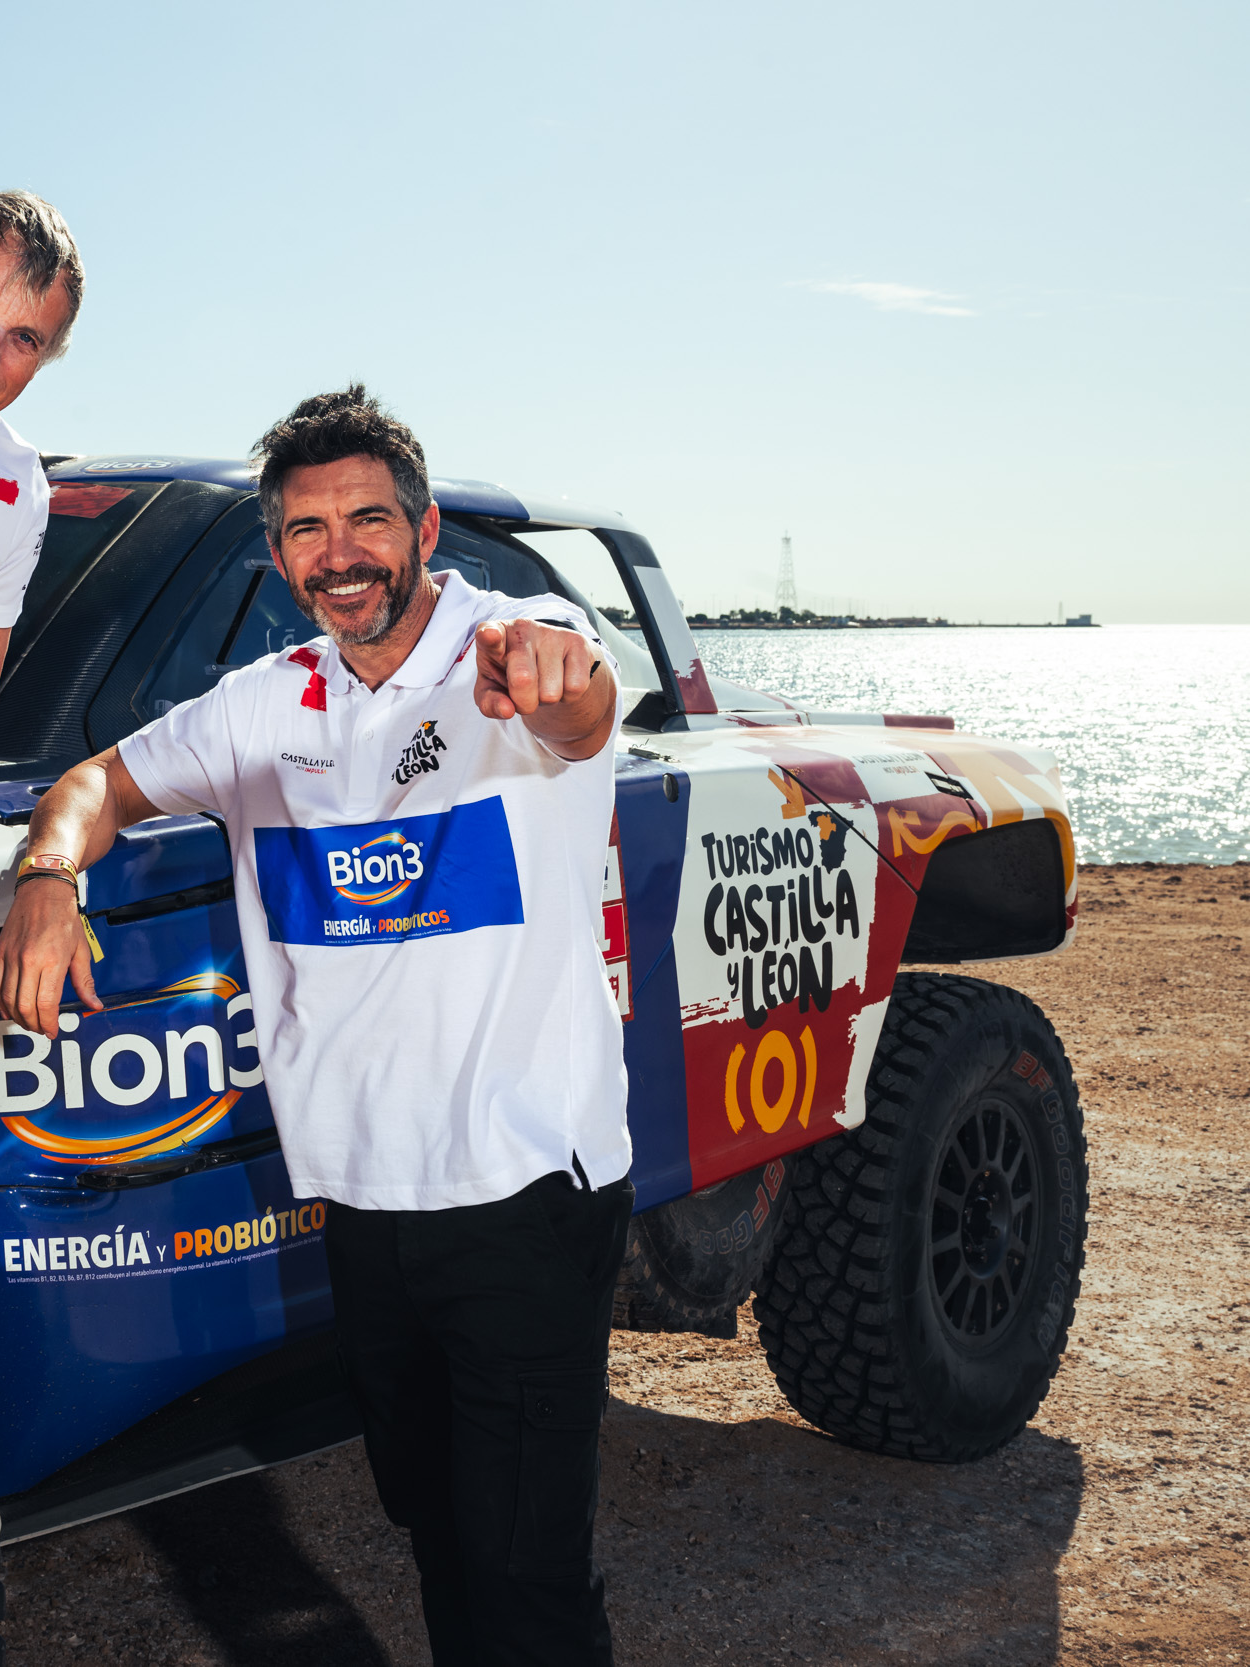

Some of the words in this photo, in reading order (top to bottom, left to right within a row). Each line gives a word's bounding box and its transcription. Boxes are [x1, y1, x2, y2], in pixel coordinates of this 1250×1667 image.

[281, 753, 319, 767] CASTILLA
[742, 940, 834, 1030] LEÓN
[174, 1201, 327, 1260] PROBIÓTICO
